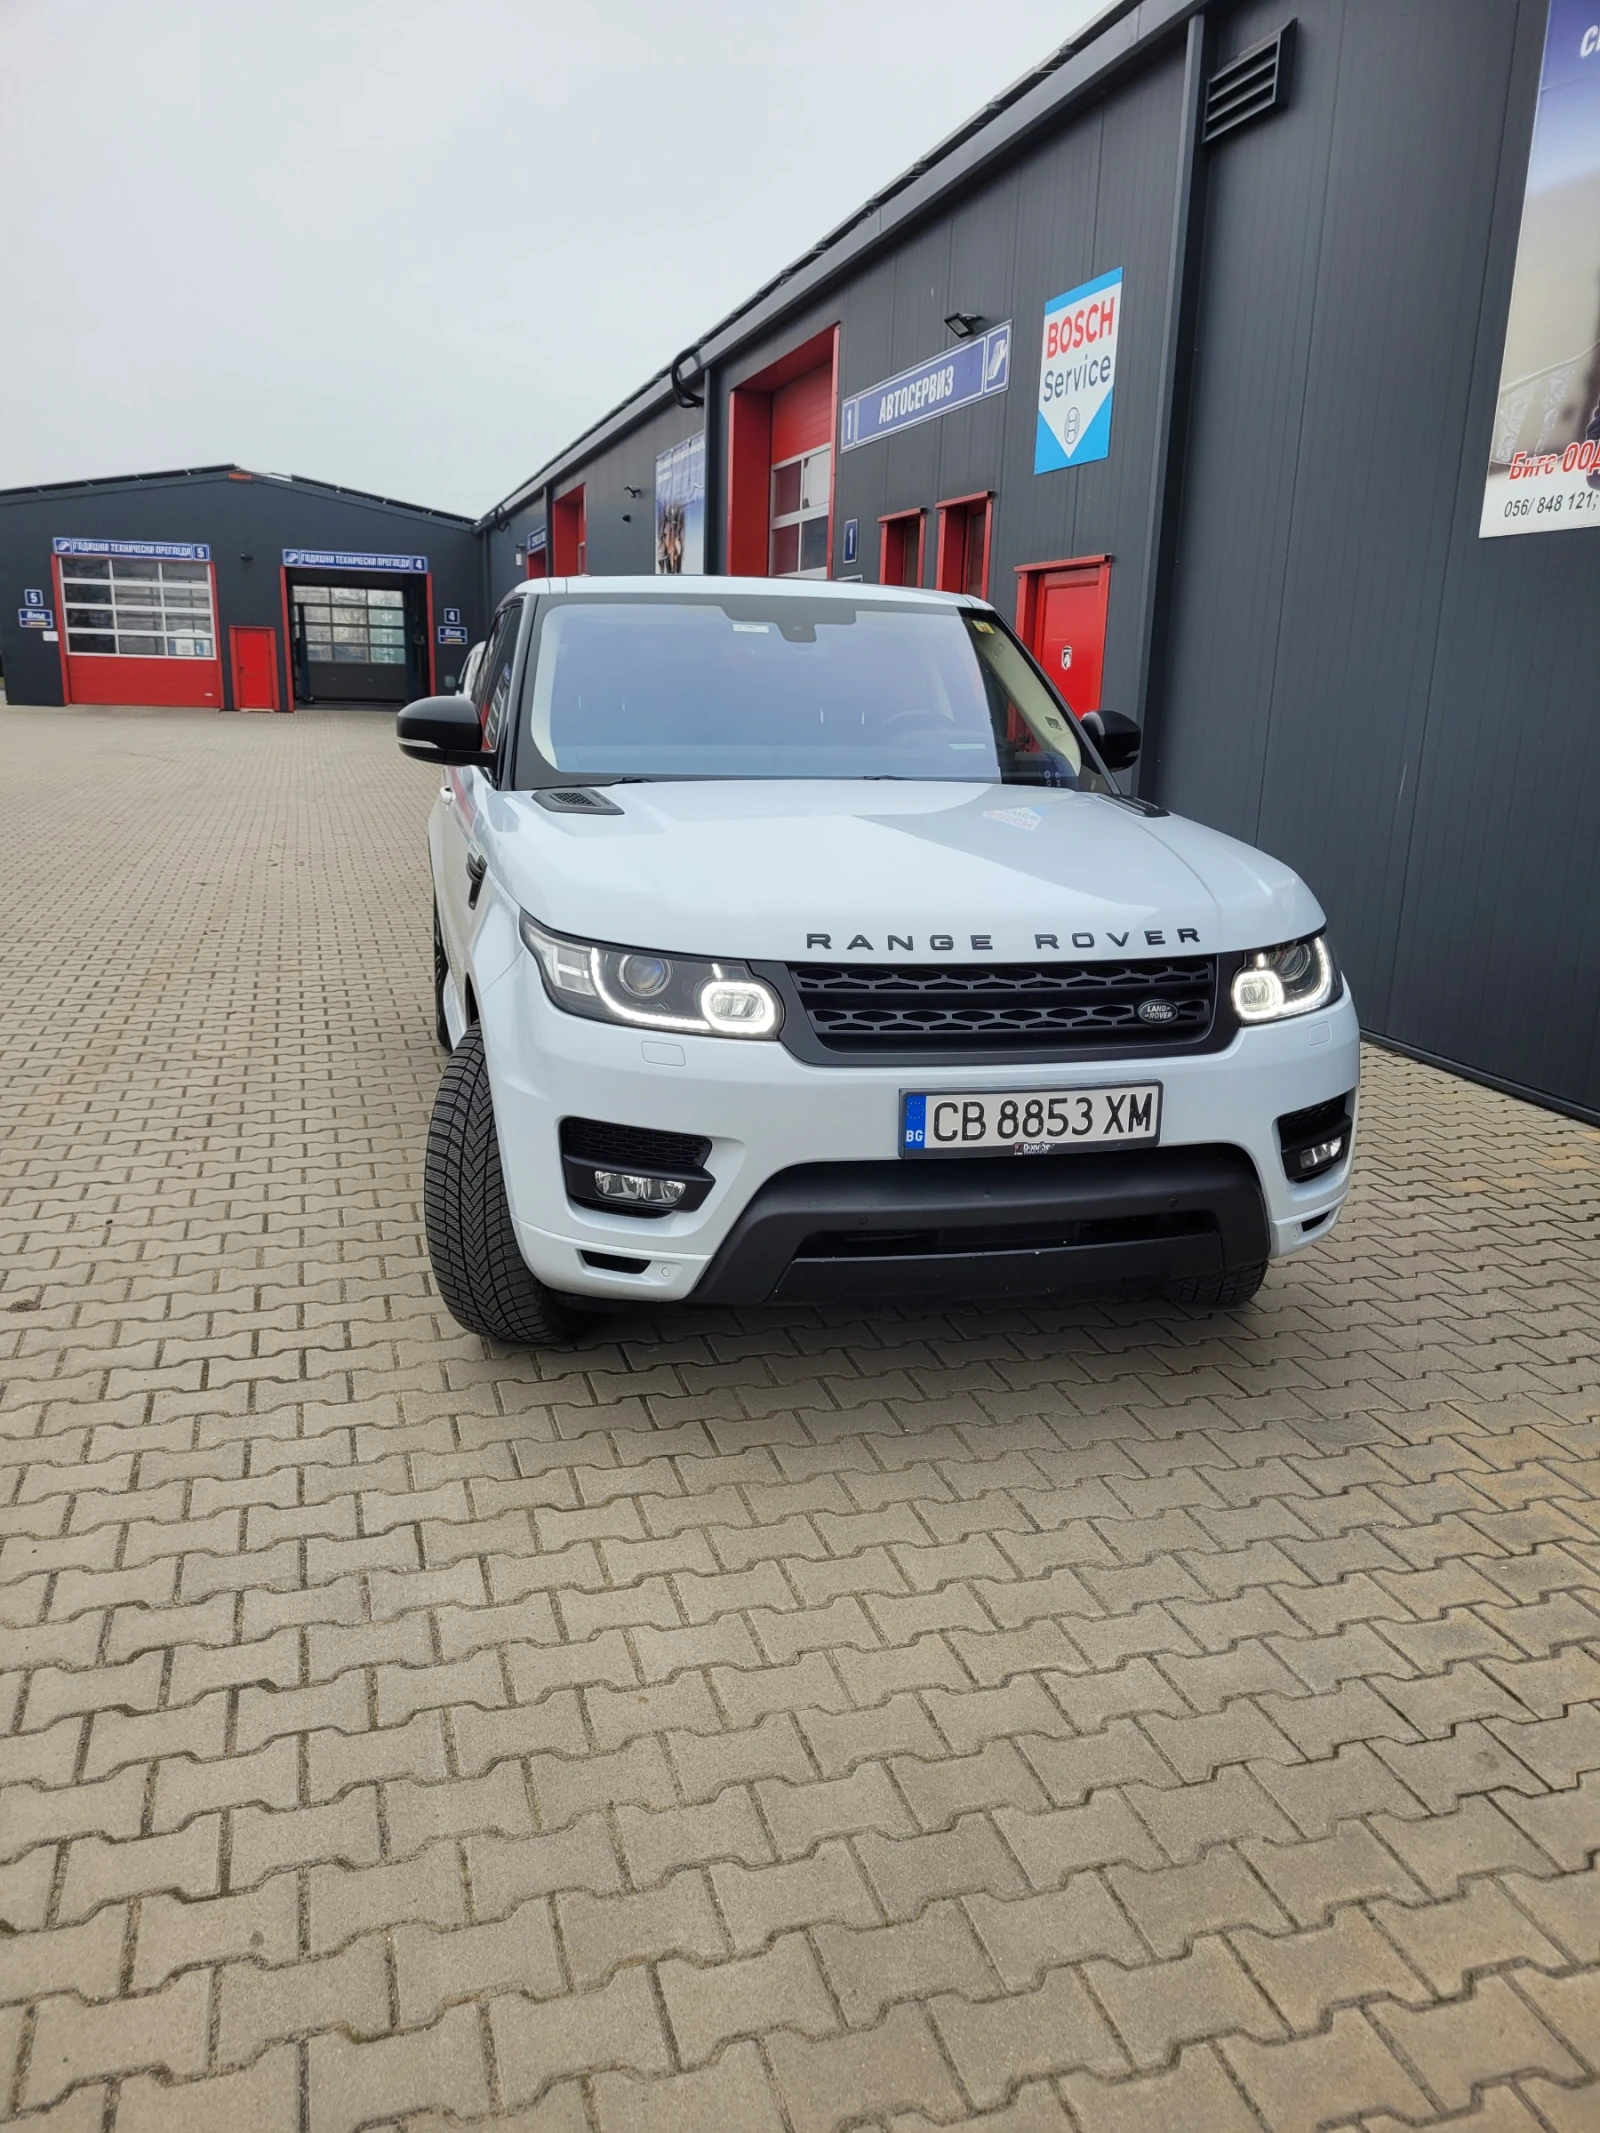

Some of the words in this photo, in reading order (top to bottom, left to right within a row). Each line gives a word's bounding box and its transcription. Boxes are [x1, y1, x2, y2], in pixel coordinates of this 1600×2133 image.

[1046, 296, 1115, 359] BOSCH
[1043, 354, 1111, 403] Service
[847, 409, 852, 440] 1
[878, 365, 955, 425] АВТОСЕРВИЗ
[1509, 451, 1558, 480] Бигс
[1504, 497, 1535, 518] 056/
[1536, 494, 1564, 514] 848
[1567, 490, 1599, 511] 121;
[197, 547, 205, 558] 5
[849, 527, 854, 555] 1
[415, 559, 422, 570] 4
[30, 592, 38, 603] 5
[448, 611, 456, 621] 4
[806, 933, 994, 951] RANGE
[1034, 927, 1201, 950] ROVER
[1149, 1011, 1173, 1019] ROVER
[933, 1101, 987, 1141] CB
[997, 1097, 1093, 1139] 8853
[1103, 1093, 1153, 1135] XM
[906, 1130, 923, 1142] BG
